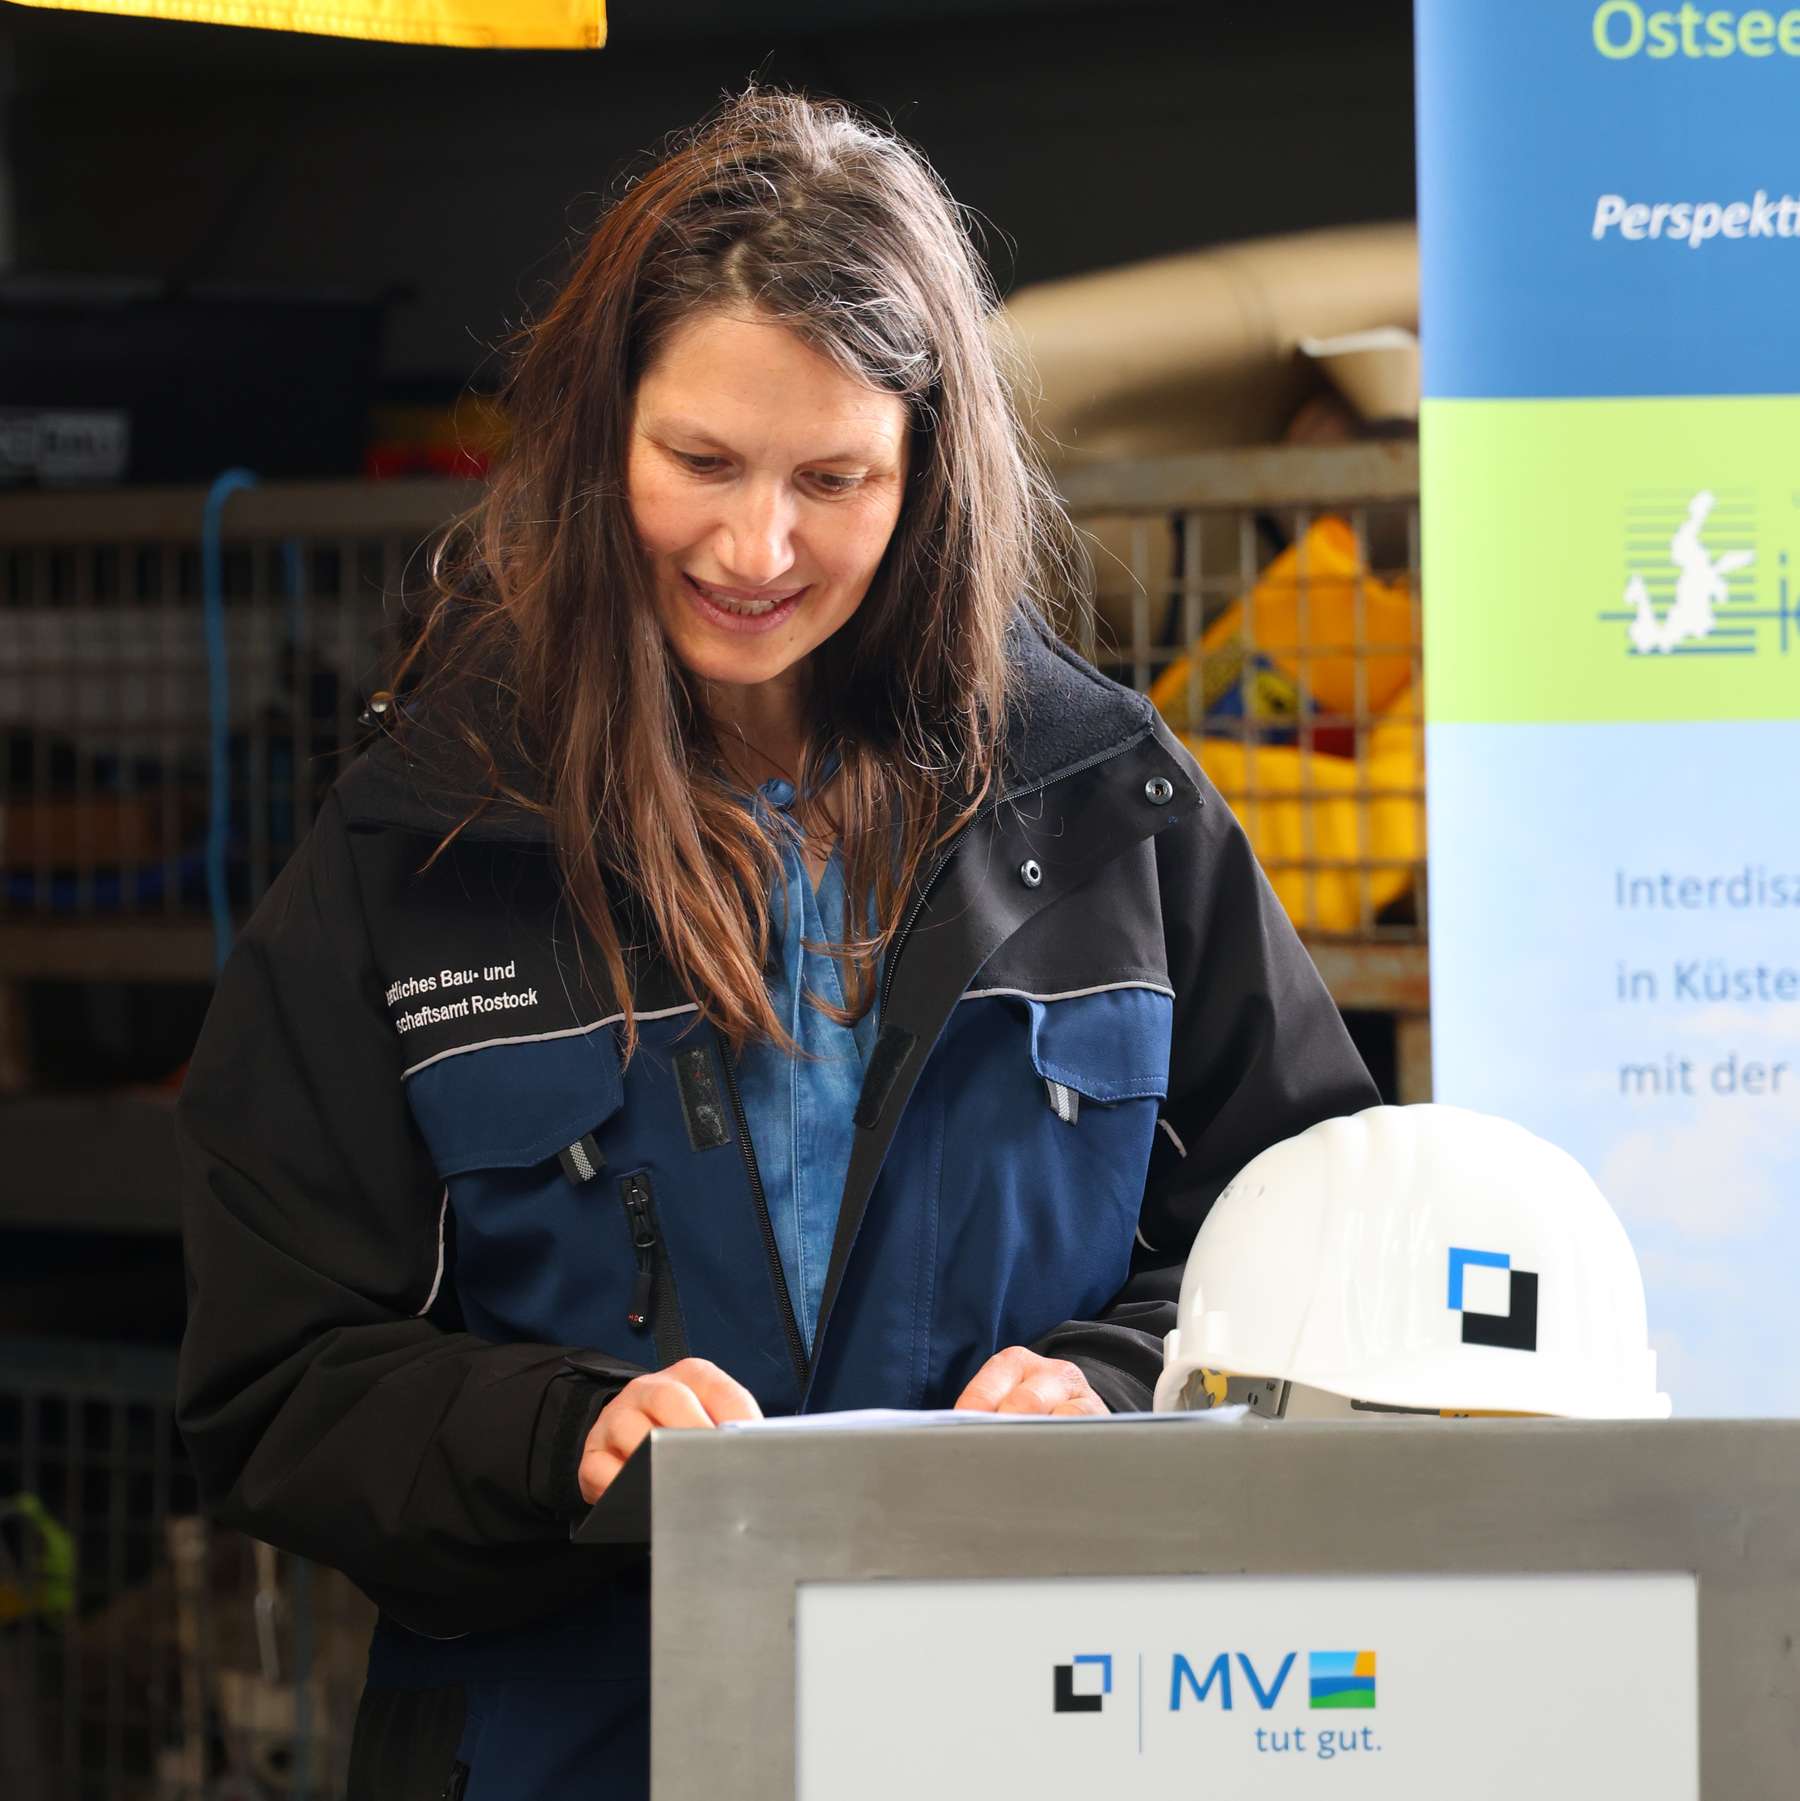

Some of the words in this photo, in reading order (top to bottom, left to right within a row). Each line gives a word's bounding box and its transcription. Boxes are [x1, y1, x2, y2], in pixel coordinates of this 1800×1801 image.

[484, 960, 516, 981] und
[1616, 960, 1657, 1001] in
[471, 987, 538, 1015] Rostock
[1618, 1052, 1696, 1096] mit
[1711, 1050, 1791, 1096] der
[1169, 1652, 1297, 1711] MV
[1254, 1726, 1306, 1752] tut
[1317, 1726, 1382, 1760] gut.
